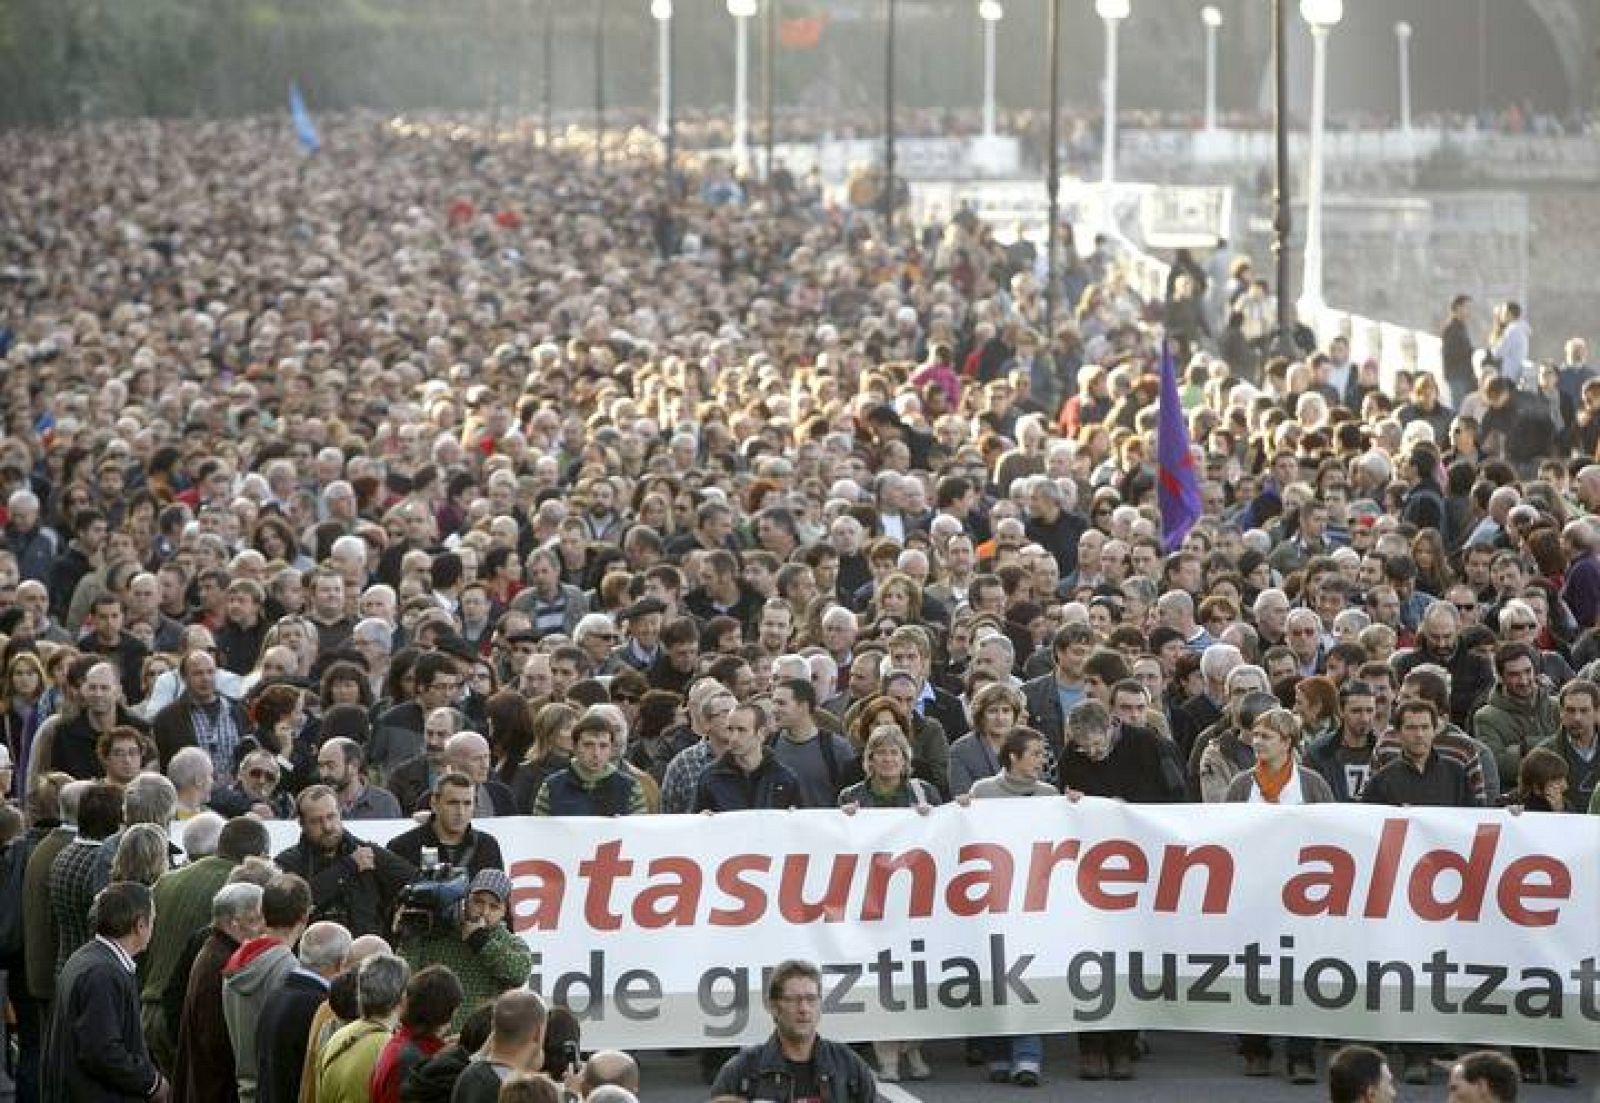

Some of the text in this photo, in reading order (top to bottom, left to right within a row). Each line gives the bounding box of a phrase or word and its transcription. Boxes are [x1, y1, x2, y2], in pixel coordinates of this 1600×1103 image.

[1282, 818, 1572, 927] alde
[698, 934, 1039, 1037] gztiak
[1067, 935, 1600, 1022] guztiontzat
